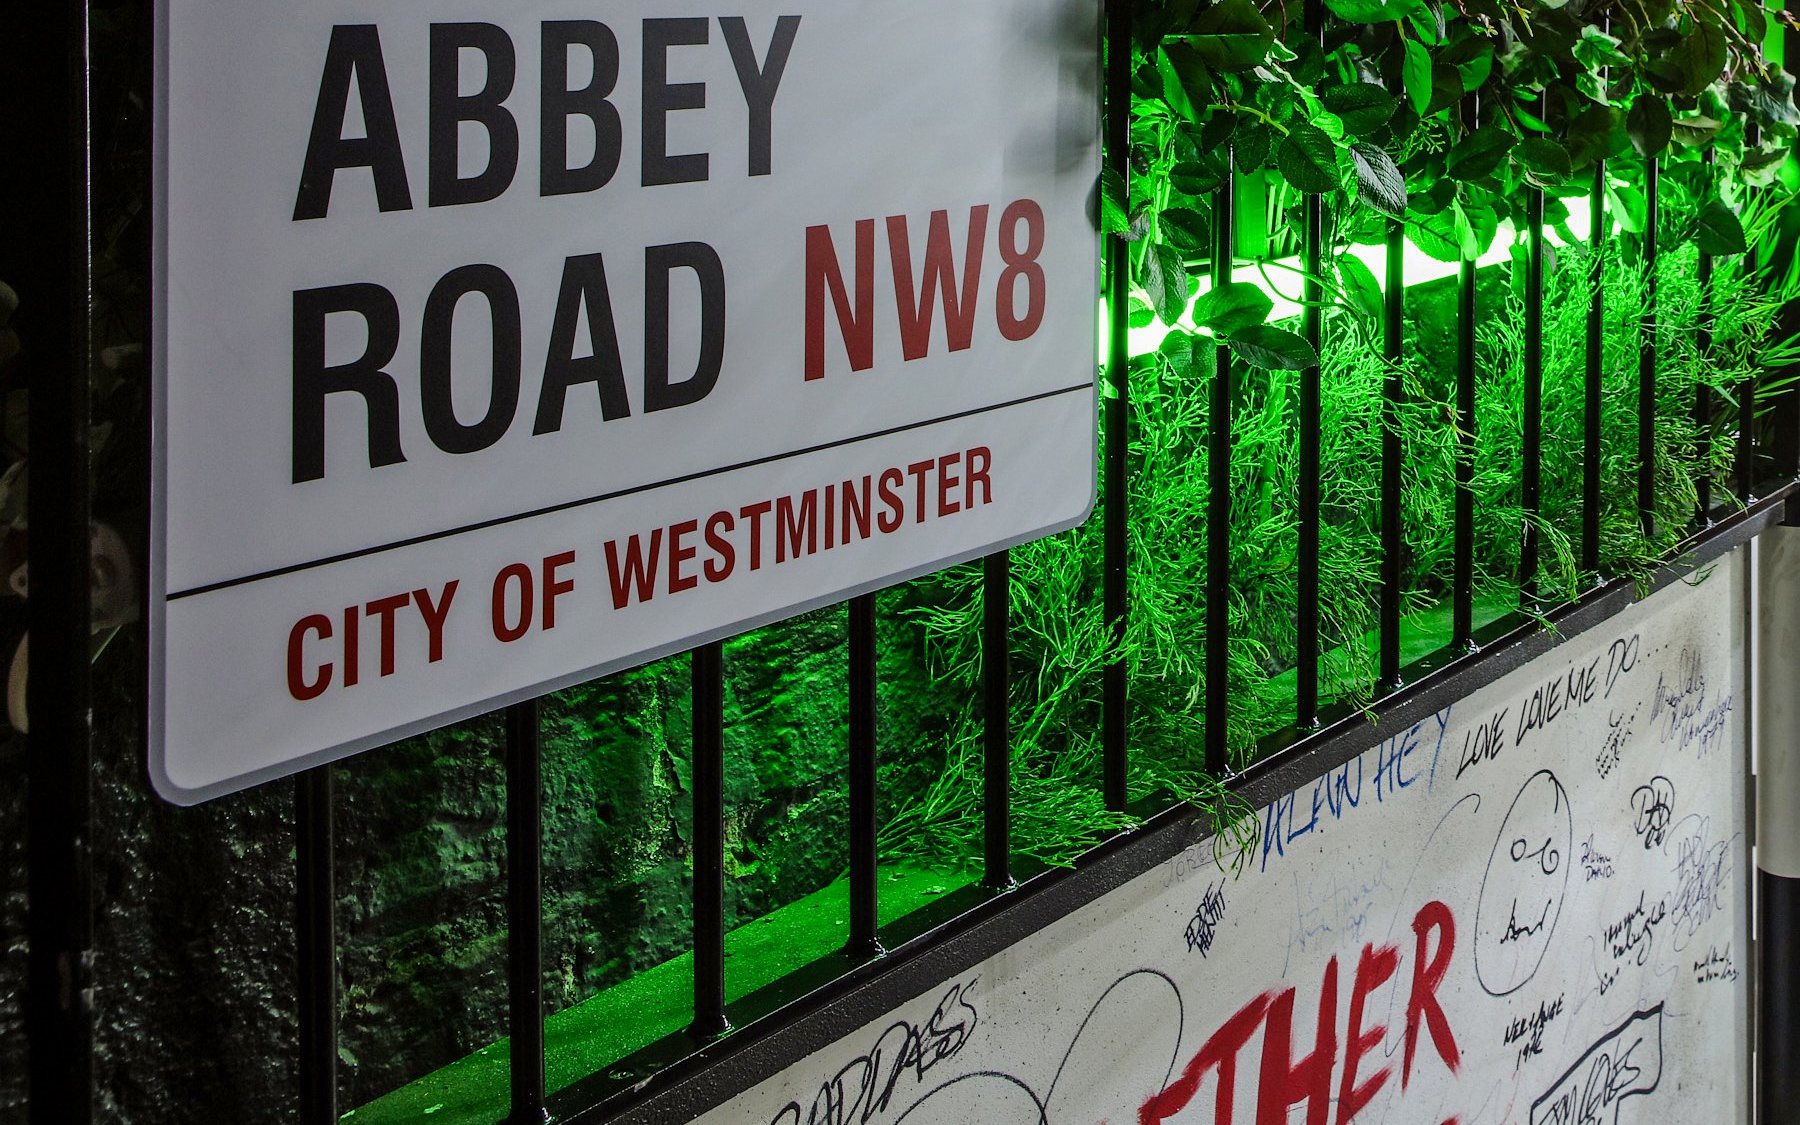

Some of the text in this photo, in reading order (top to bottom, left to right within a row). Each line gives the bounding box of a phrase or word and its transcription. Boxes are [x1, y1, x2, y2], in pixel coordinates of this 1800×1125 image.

[293, 13, 803, 222] ABBEY
[291, 198, 1047, 485] ROAD NW8
[286, 445, 994, 702] CITY OF WESTMINSTER
[1455, 707, 1509, 781] LOVE
[1515, 676, 1563, 747] LOVE
[1563, 656, 1601, 711] ME
